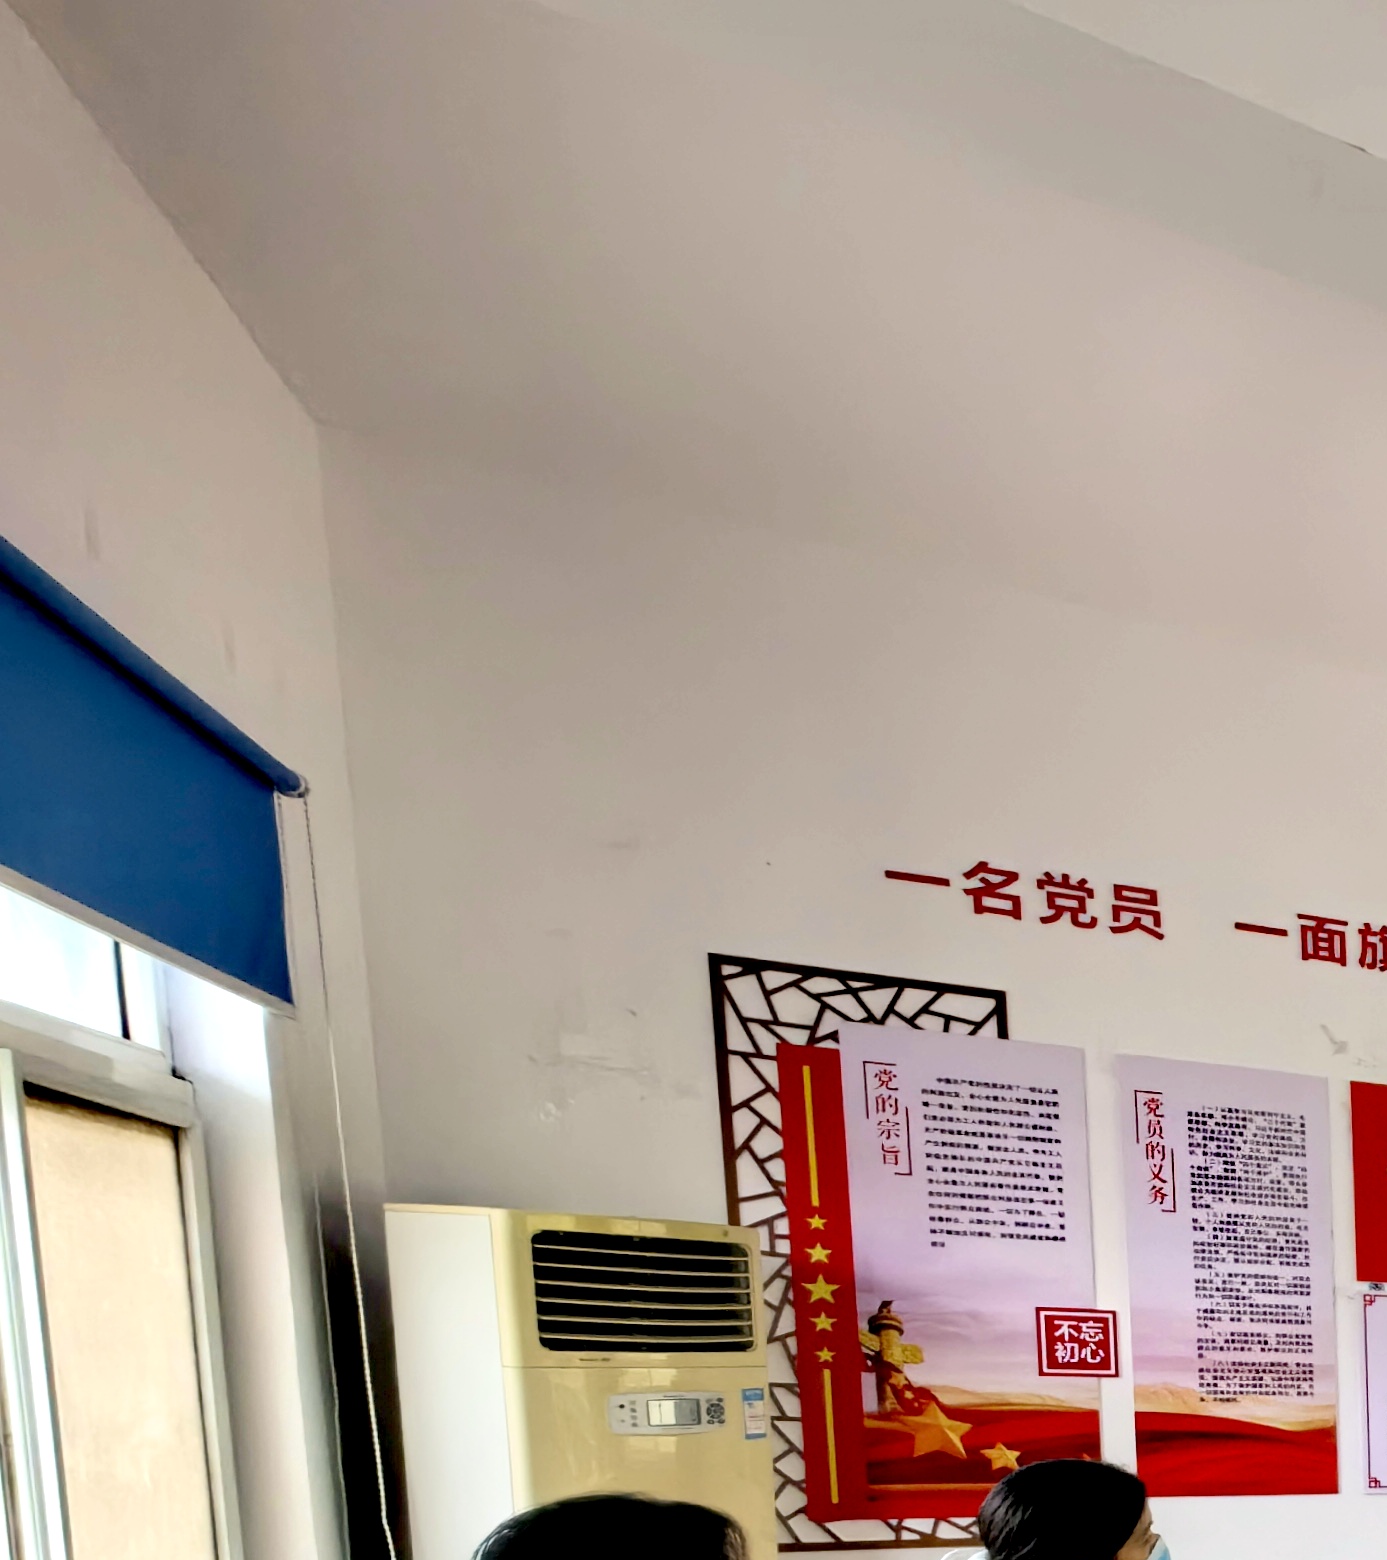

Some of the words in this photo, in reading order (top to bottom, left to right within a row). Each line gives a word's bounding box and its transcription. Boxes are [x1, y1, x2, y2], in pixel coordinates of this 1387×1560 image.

[884, 860, 1165, 941] 一名党员
[873, 1068, 901, 1167] 党的宗旨
[1142, 1096, 1169, 1205] 党员的义务
[1053, 1319, 1104, 1342] 不忘
[1053, 1342, 1105, 1363] 初心
